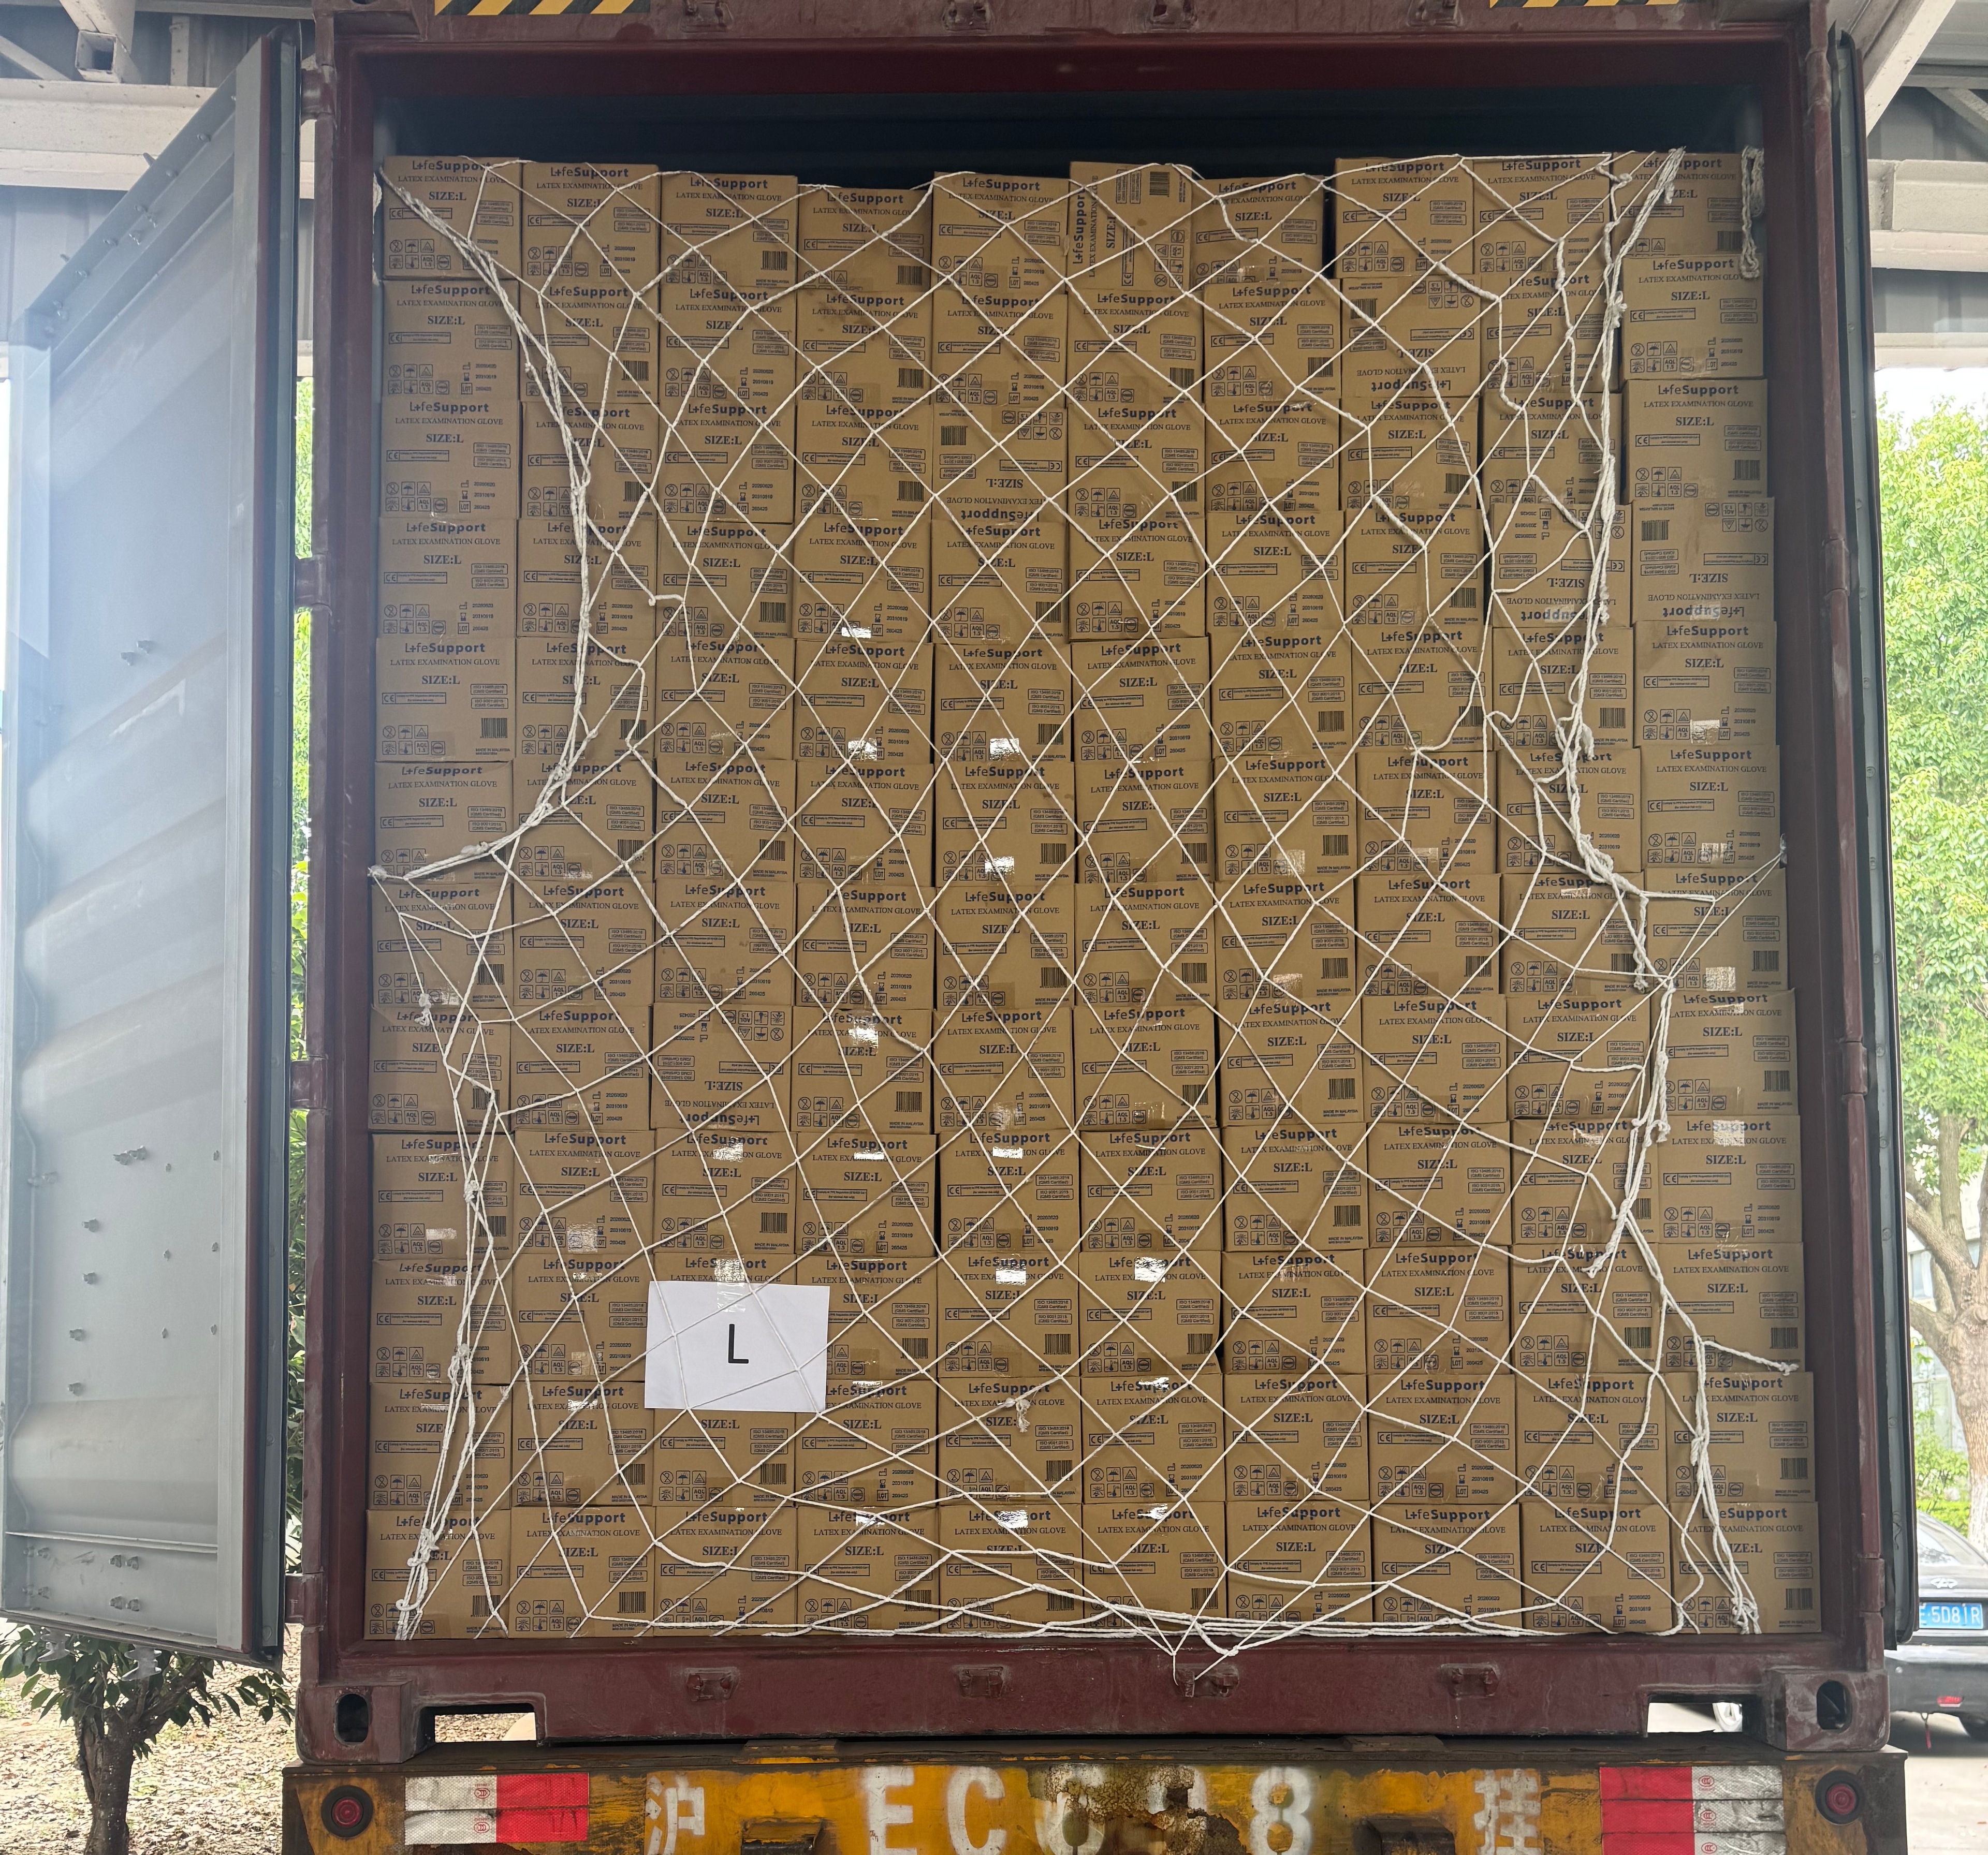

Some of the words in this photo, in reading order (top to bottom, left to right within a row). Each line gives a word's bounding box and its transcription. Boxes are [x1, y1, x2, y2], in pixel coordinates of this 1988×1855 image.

[429, 192, 466, 201] SIZE:L
[706, 209, 743, 218] SIZE:L
[1671, 291, 1710, 301] SIZE:L
[428, 316, 465, 325] SIZE:L
[1676, 417, 1715, 426] SIZE:L
[426, 434, 464, 443] SIZE:L
[1388, 430, 1427, 439] SIZE:L
[705, 436, 742, 445] SIZE:L
[1254, 547, 1292, 556] SIZE:L
[423, 555, 461, 565] SIZE:L
[1116, 552, 1154, 562] SIZE:L
[703, 558, 741, 568] SIZE:L
[1685, 658, 1724, 668] SIZE:L
[1540, 665, 1579, 674] SIZE:L
[421, 675, 460, 685] SIZE:L
[841, 678, 879, 687] SIZE:L
[1690, 782, 1729, 791] SIZE:L
[701, 794, 740, 804] SIZE:L
[1263, 792, 1302, 802] SIZE:L
[419, 798, 458, 807] SIZE:L
[1552, 910, 1590, 919] SIZE:L
[701, 918, 740, 928] SIZE:L
[1703, 1027, 1743, 1037] SIZE:L
[556, 1043, 595, 1053] SIZE:L
[1706, 1155, 1746, 1165] SIZE:L
[1274, 1162, 1313, 1172] SIZE:L
[844, 1172, 883, 1181] SIZE:L
[1271, 1288, 1311, 1298] SIZE:L
[1414, 1287, 1454, 1297] SIZE:L
[1707, 1283, 1748, 1293] SIZE:L
[728, 1324, 749, 1363] L
[1274, 1413, 1313, 1423] SIZE:L
[1420, 1415, 1460, 1424] SIZE:L
[1717, 1412, 1758, 1423] SIZE:L
[700, 1419, 740, 1429] SIZE:L
[1276, 1542, 1316, 1552] SIZE:L
